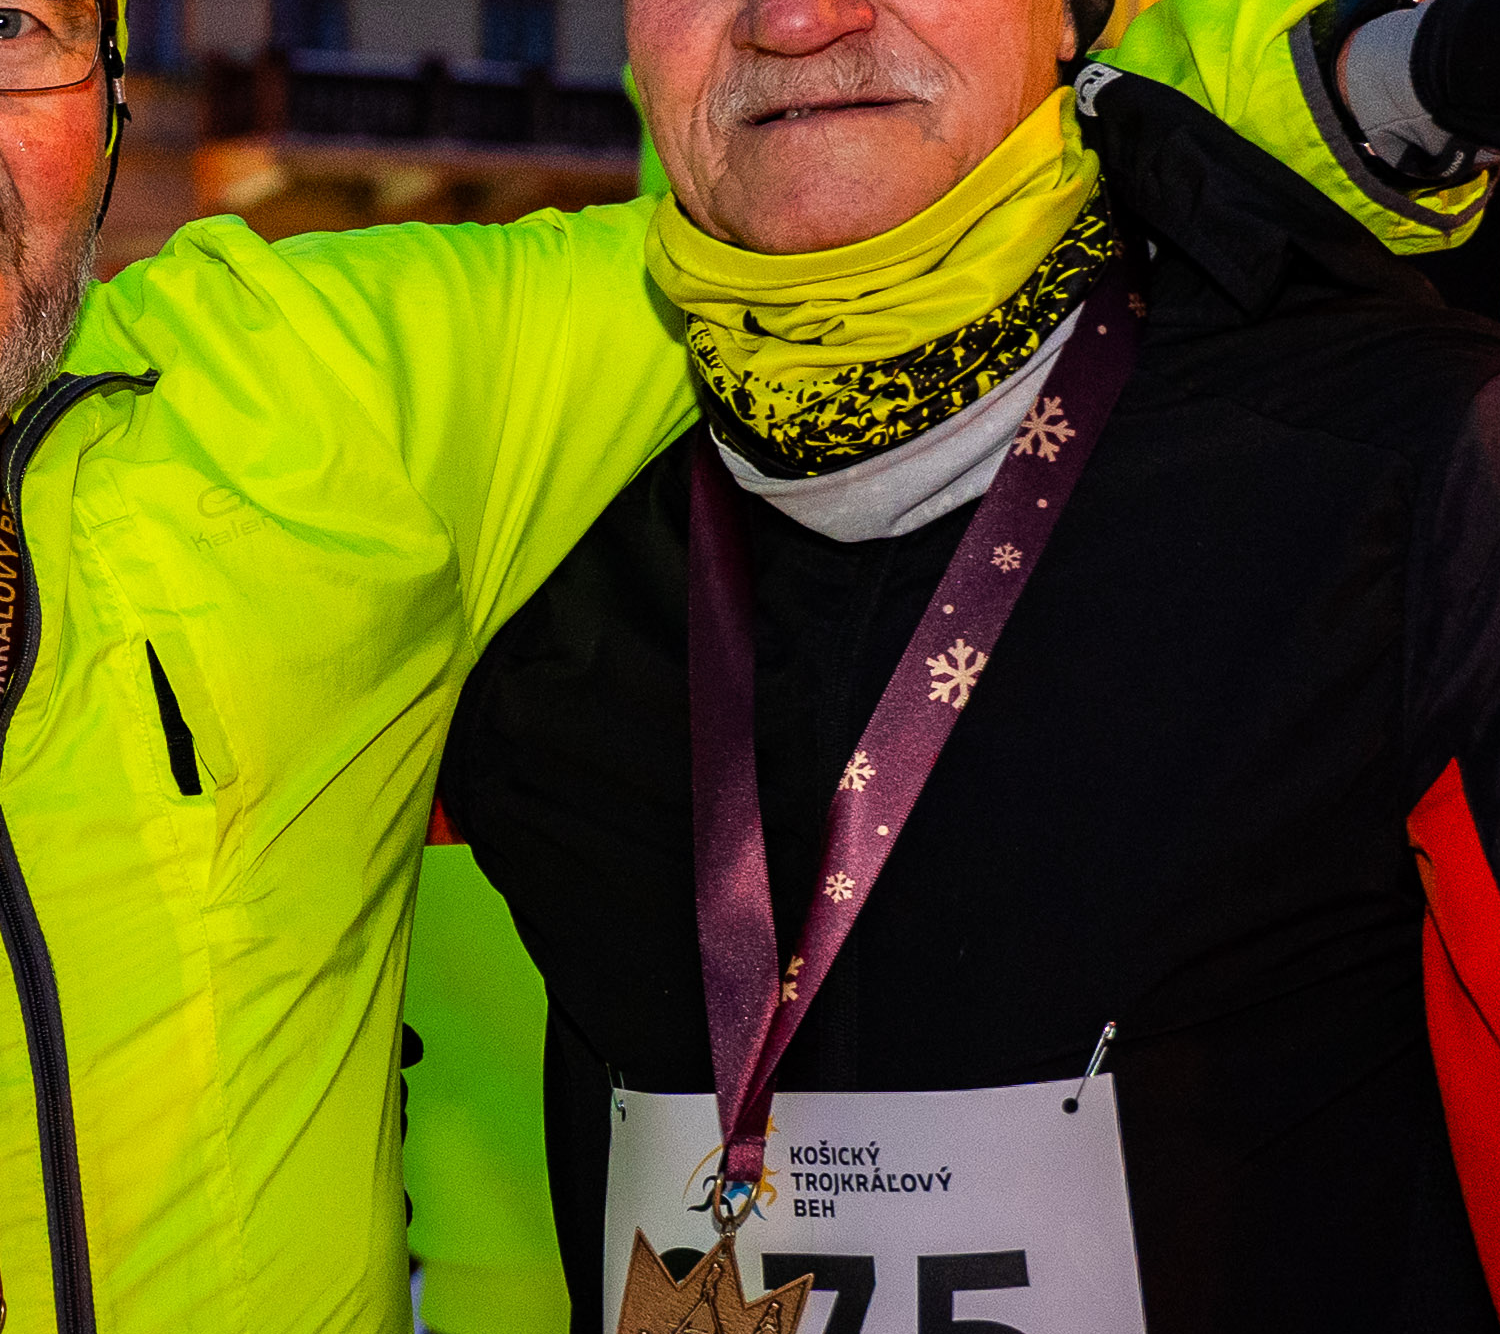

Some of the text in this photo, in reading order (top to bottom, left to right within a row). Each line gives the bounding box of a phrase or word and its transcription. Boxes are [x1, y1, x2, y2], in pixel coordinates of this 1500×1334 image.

[790, 1140, 880, 1166] KOŠICKÝ
[790, 1167, 952, 1195] TROJKRÁĽOVÝ
[794, 1198, 836, 1217] BEH
